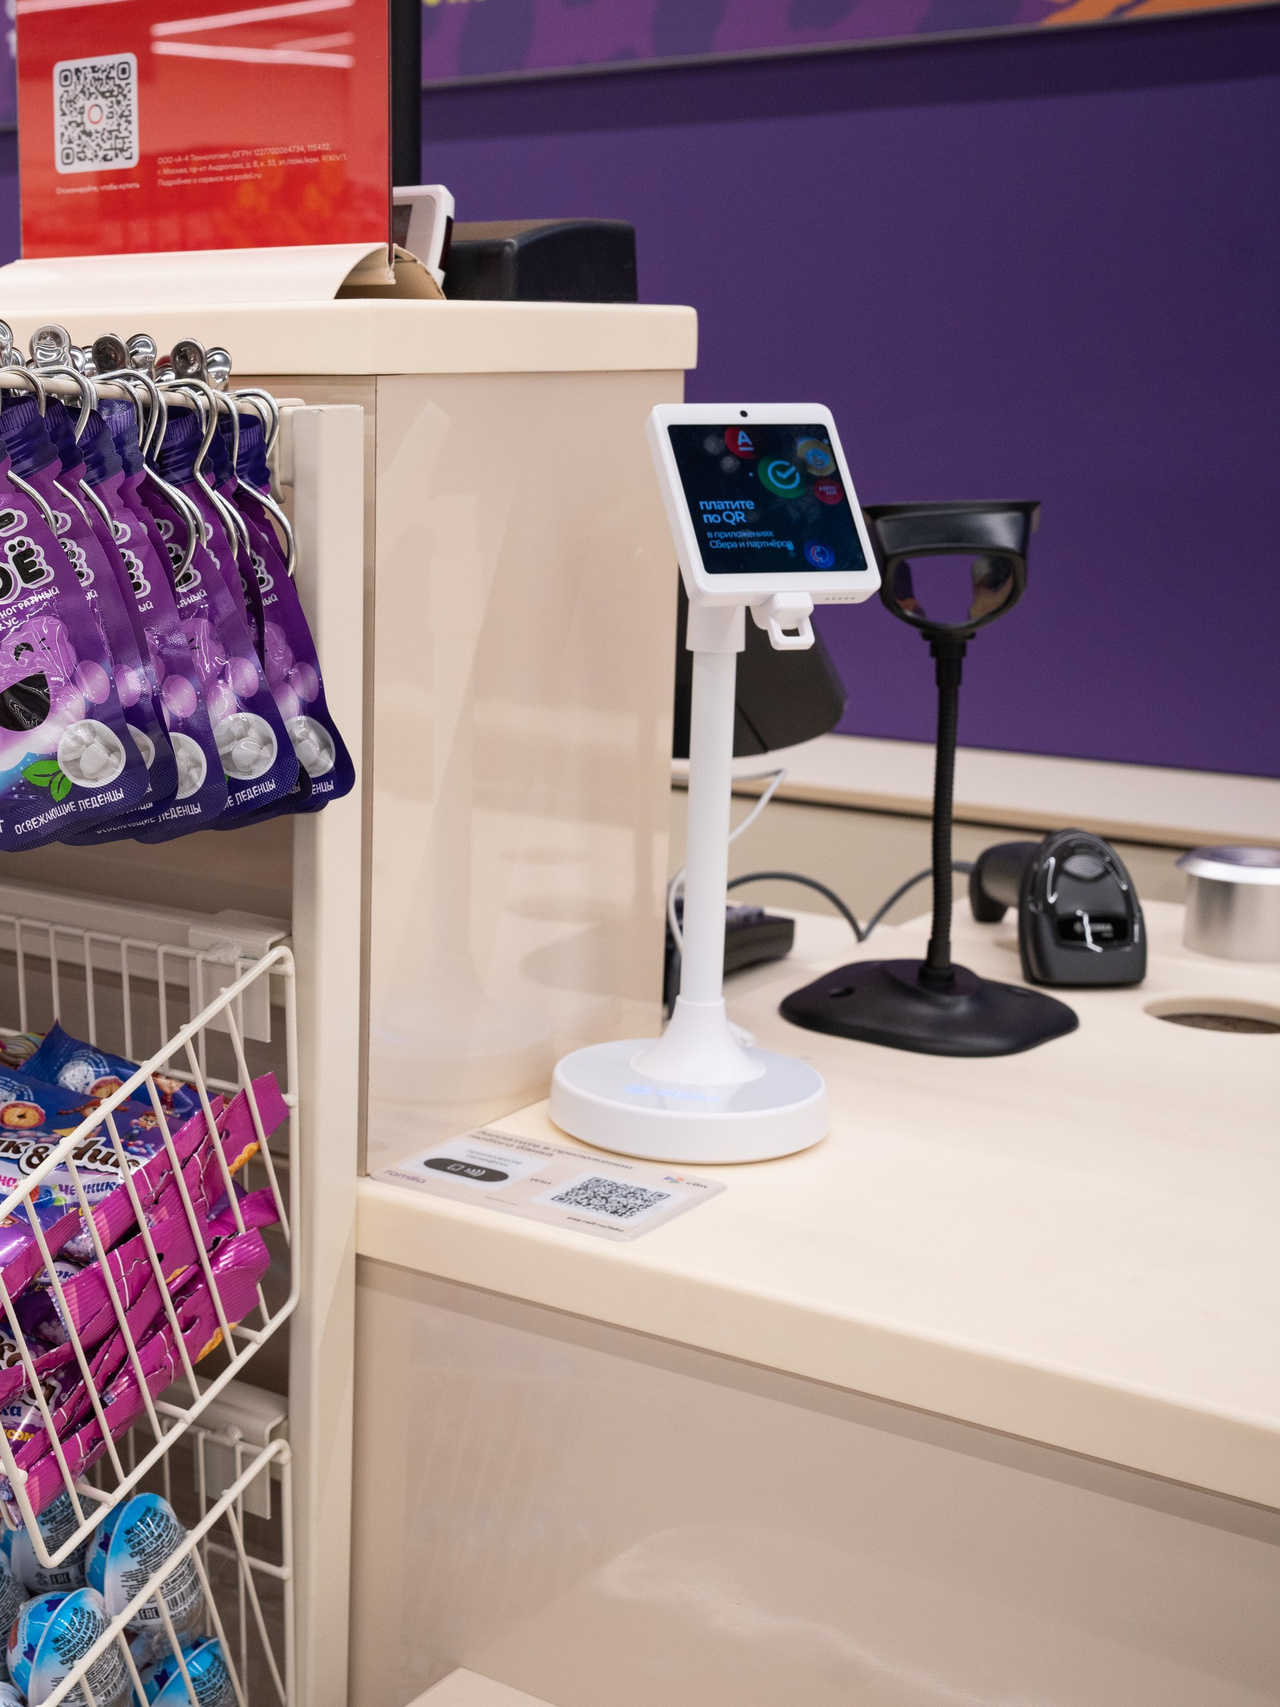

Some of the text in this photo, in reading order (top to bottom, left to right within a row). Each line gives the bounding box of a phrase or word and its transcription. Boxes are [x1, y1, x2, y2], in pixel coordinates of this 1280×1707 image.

[699, 499, 755, 510] платите
[703, 511, 747, 525] по QR
[714, 529, 774, 541] приложениях
[709, 539, 737, 549] Сбера
[236, 778, 277, 806] ЛЕДЕНЦЫ
[14, 801, 77, 835] ОСВЕЖАЮЩИЕ
[78, 788, 125, 812] ЛЕДЕНЦЫ
